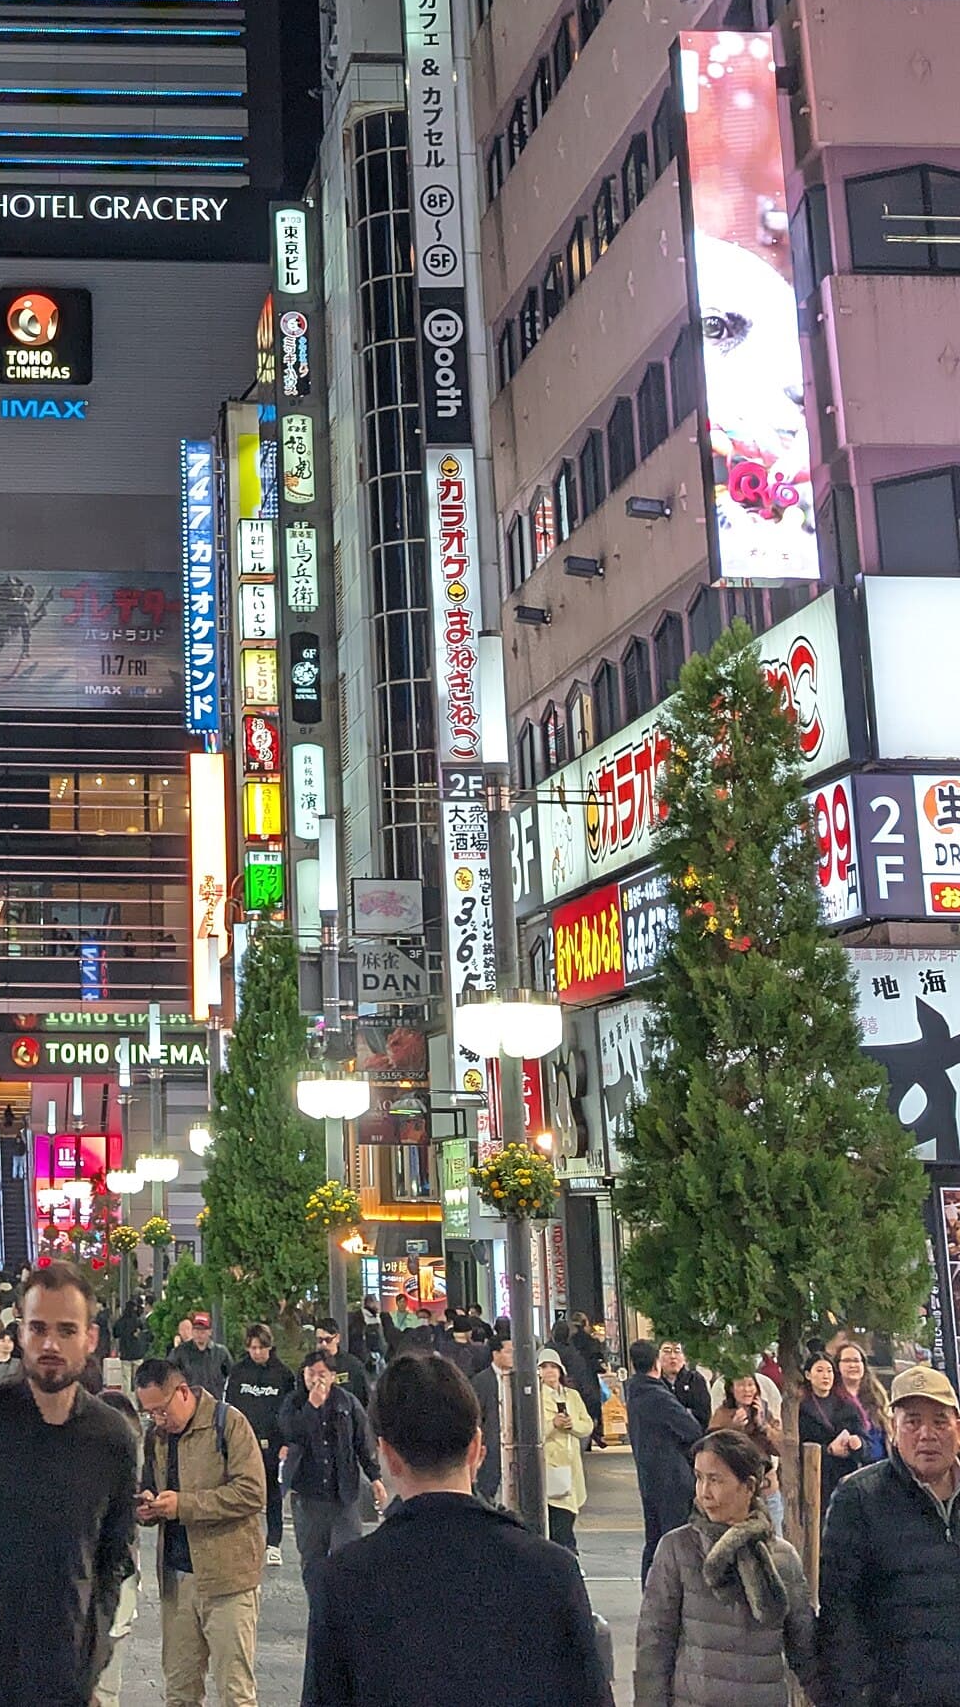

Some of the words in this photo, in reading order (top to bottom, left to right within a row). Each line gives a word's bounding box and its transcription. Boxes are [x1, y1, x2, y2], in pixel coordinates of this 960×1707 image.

[90, 196, 228, 222] GRACERY
[426, 193, 449, 209] 8F
[284, 226, 300, 286] 東京ビル
[430, 252, 451, 269] 5F
[6, 350, 53, 366] TOHO
[6, 367, 71, 379] CINEMAS
[0, 399, 85, 419] IMAX
[439, 478, 469, 582] カラオケ
[249, 522, 265, 572] 川新ビル
[60, 582, 182, 626] プレデター
[253, 586, 266, 637] たいむら
[189, 539, 215, 720] カラオケランド
[100, 654, 125, 676] 11.7
[127, 659, 147, 676] FRI
[84, 685, 121, 695] IMAX
[442, 605, 482, 760] まねきねこ
[449, 771, 483, 798] 2F
[363, 952, 400, 970] 麻雀
[409, 950, 423, 959] 3F
[362, 974, 420, 991] DAN
[45, 1043, 109, 1064] TOHO
